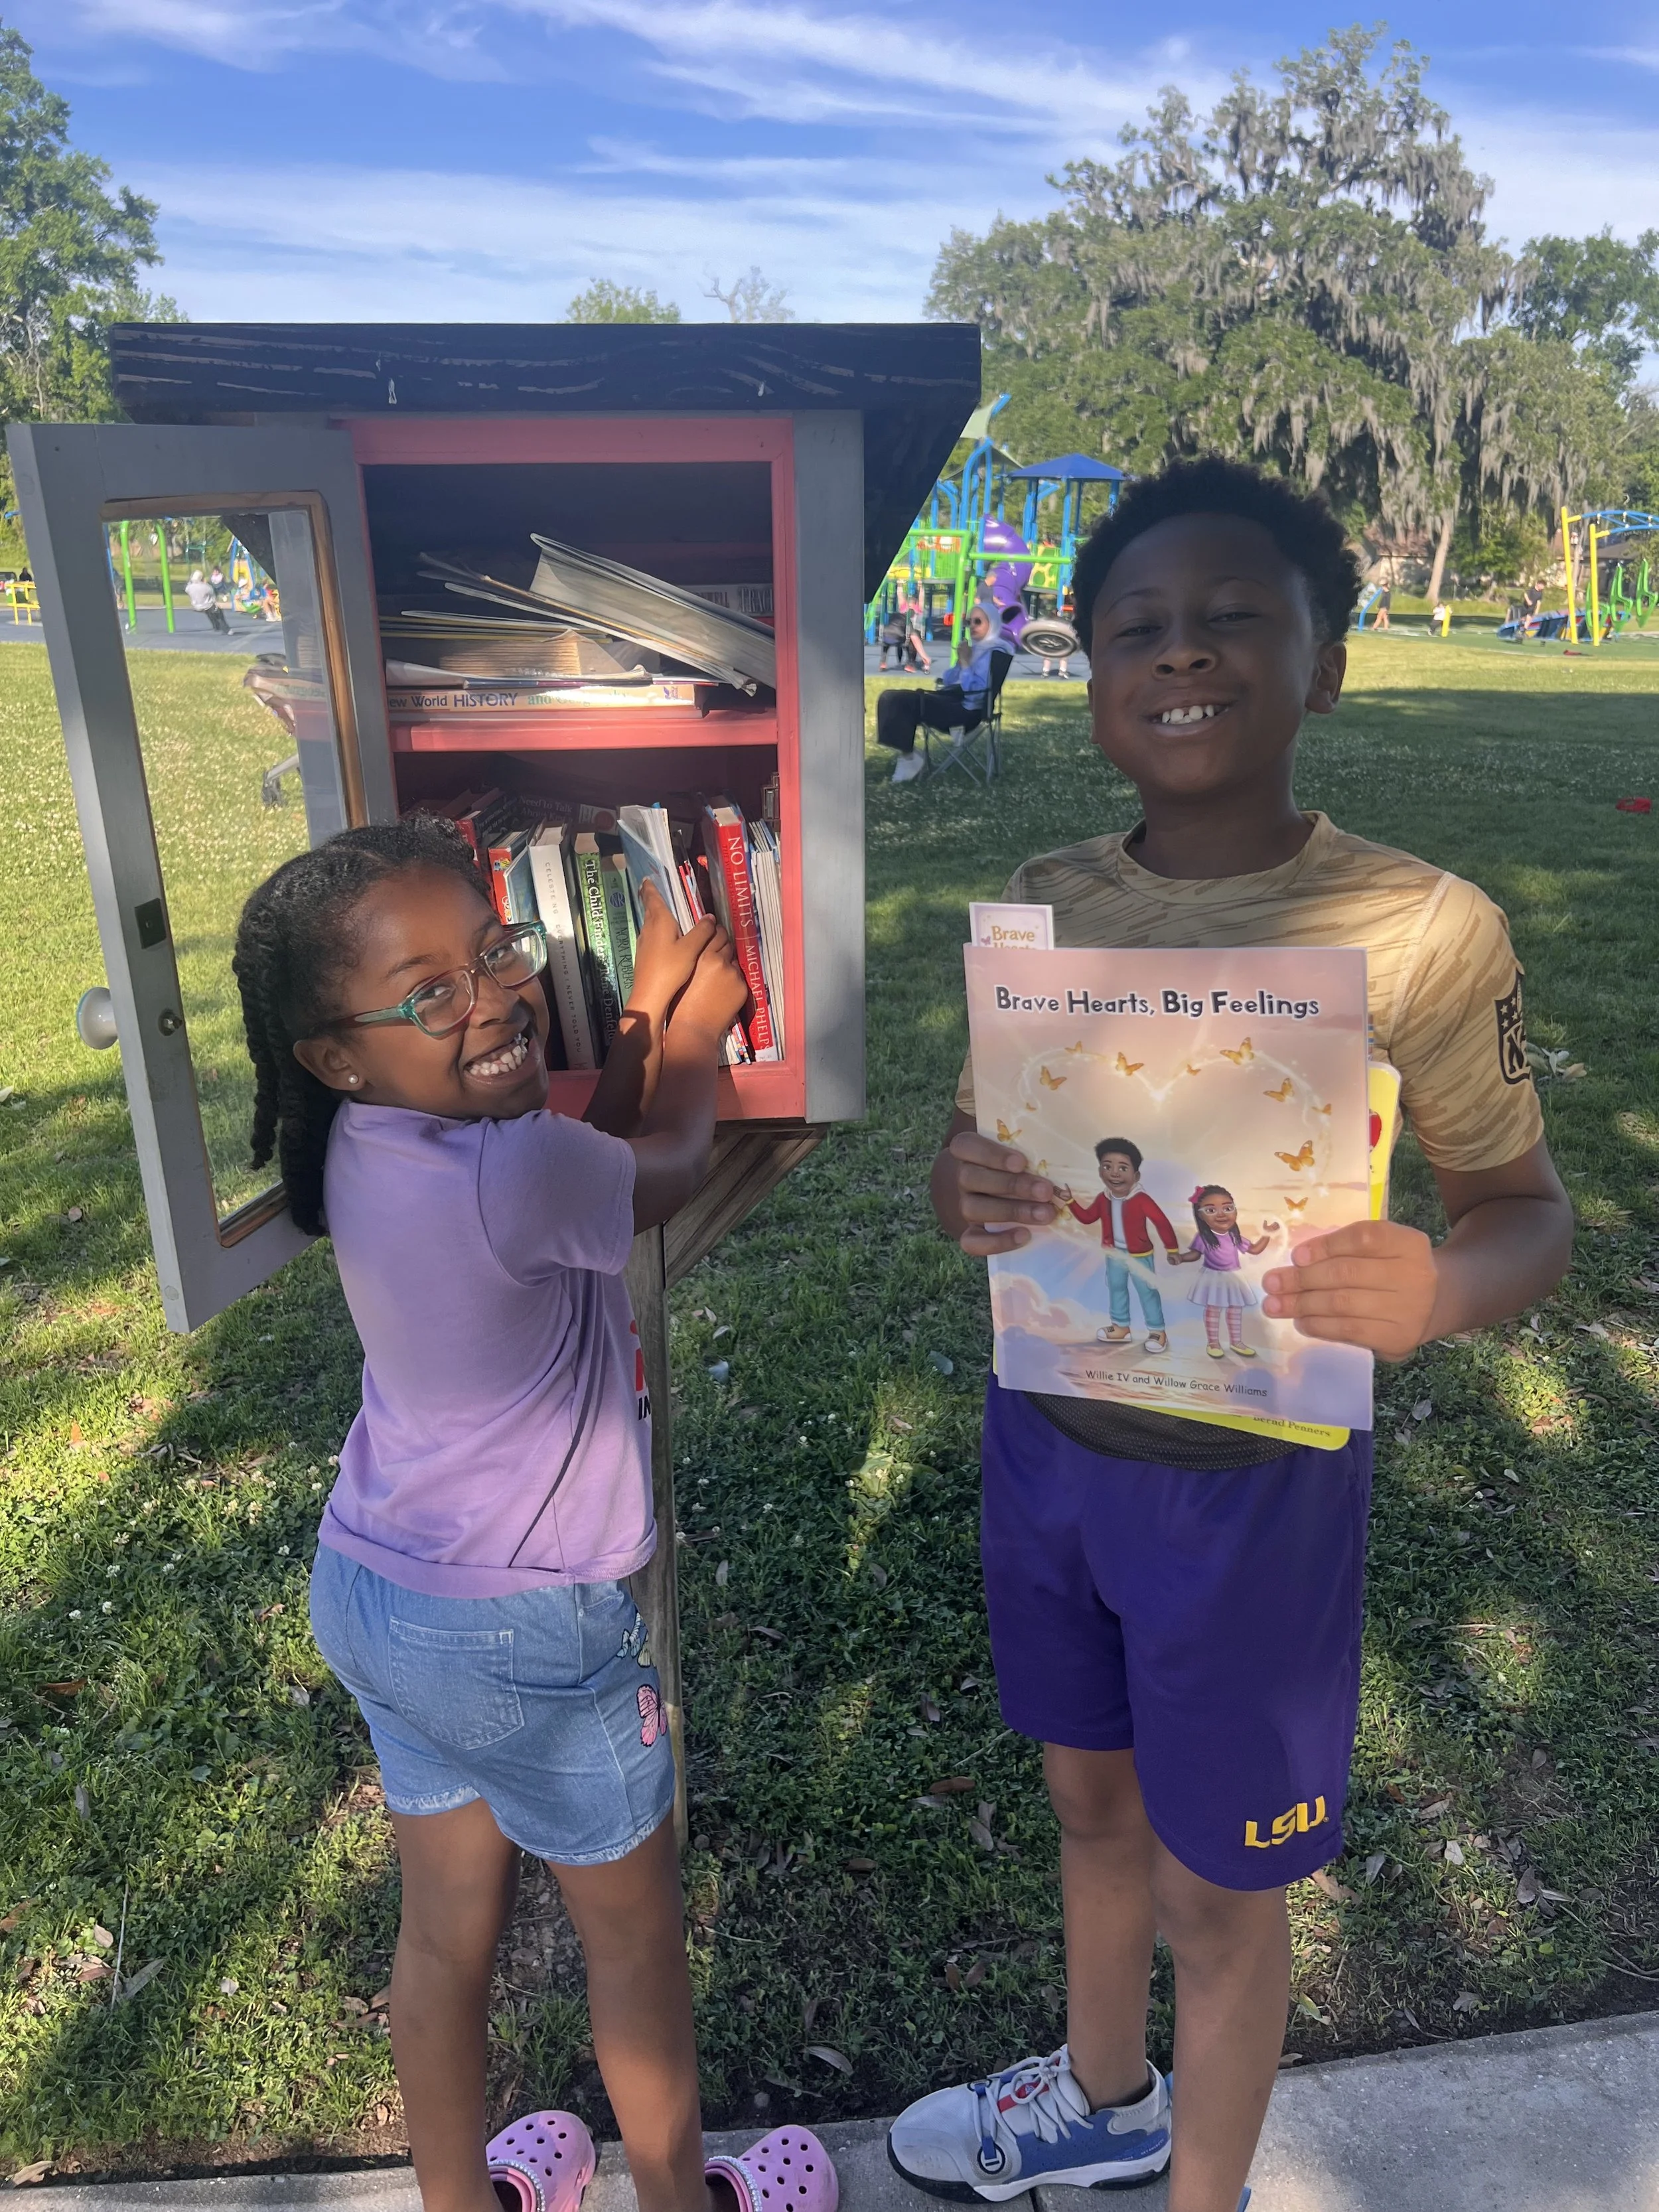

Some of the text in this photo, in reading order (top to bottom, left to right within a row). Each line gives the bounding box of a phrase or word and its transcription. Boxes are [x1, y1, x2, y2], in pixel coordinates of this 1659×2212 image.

[389, 696, 407, 708] ew
[411, 695, 447, 707] World
[453, 692, 518, 708] HISTORY
[528, 694, 551, 705] and
[519, 795, 538, 808] Need
[555, 800, 573, 814] Talk
[545, 861, 559, 915] CELESTE NG
[728, 837, 754, 928] NO LIMITS
[585, 859, 607, 960] The Child Finder
[615, 927, 630, 953] NORA
[991, 925, 1035, 942] Brave
[555, 924, 569, 975] EVERYTHING
[565, 984, 575, 1011] NEVER
[573, 1037, 582, 1053] YOU
[995, 986, 1319, 1019] Brave Hearts, Big Feelings
[756, 1007, 770, 1050] PHELPS
[1086, 1369, 1267, 1397] Willie IV and Willow Grace Williams
[1288, 1420, 1331, 1437] Penners
[1244, 1795, 1326, 1848] LSU
